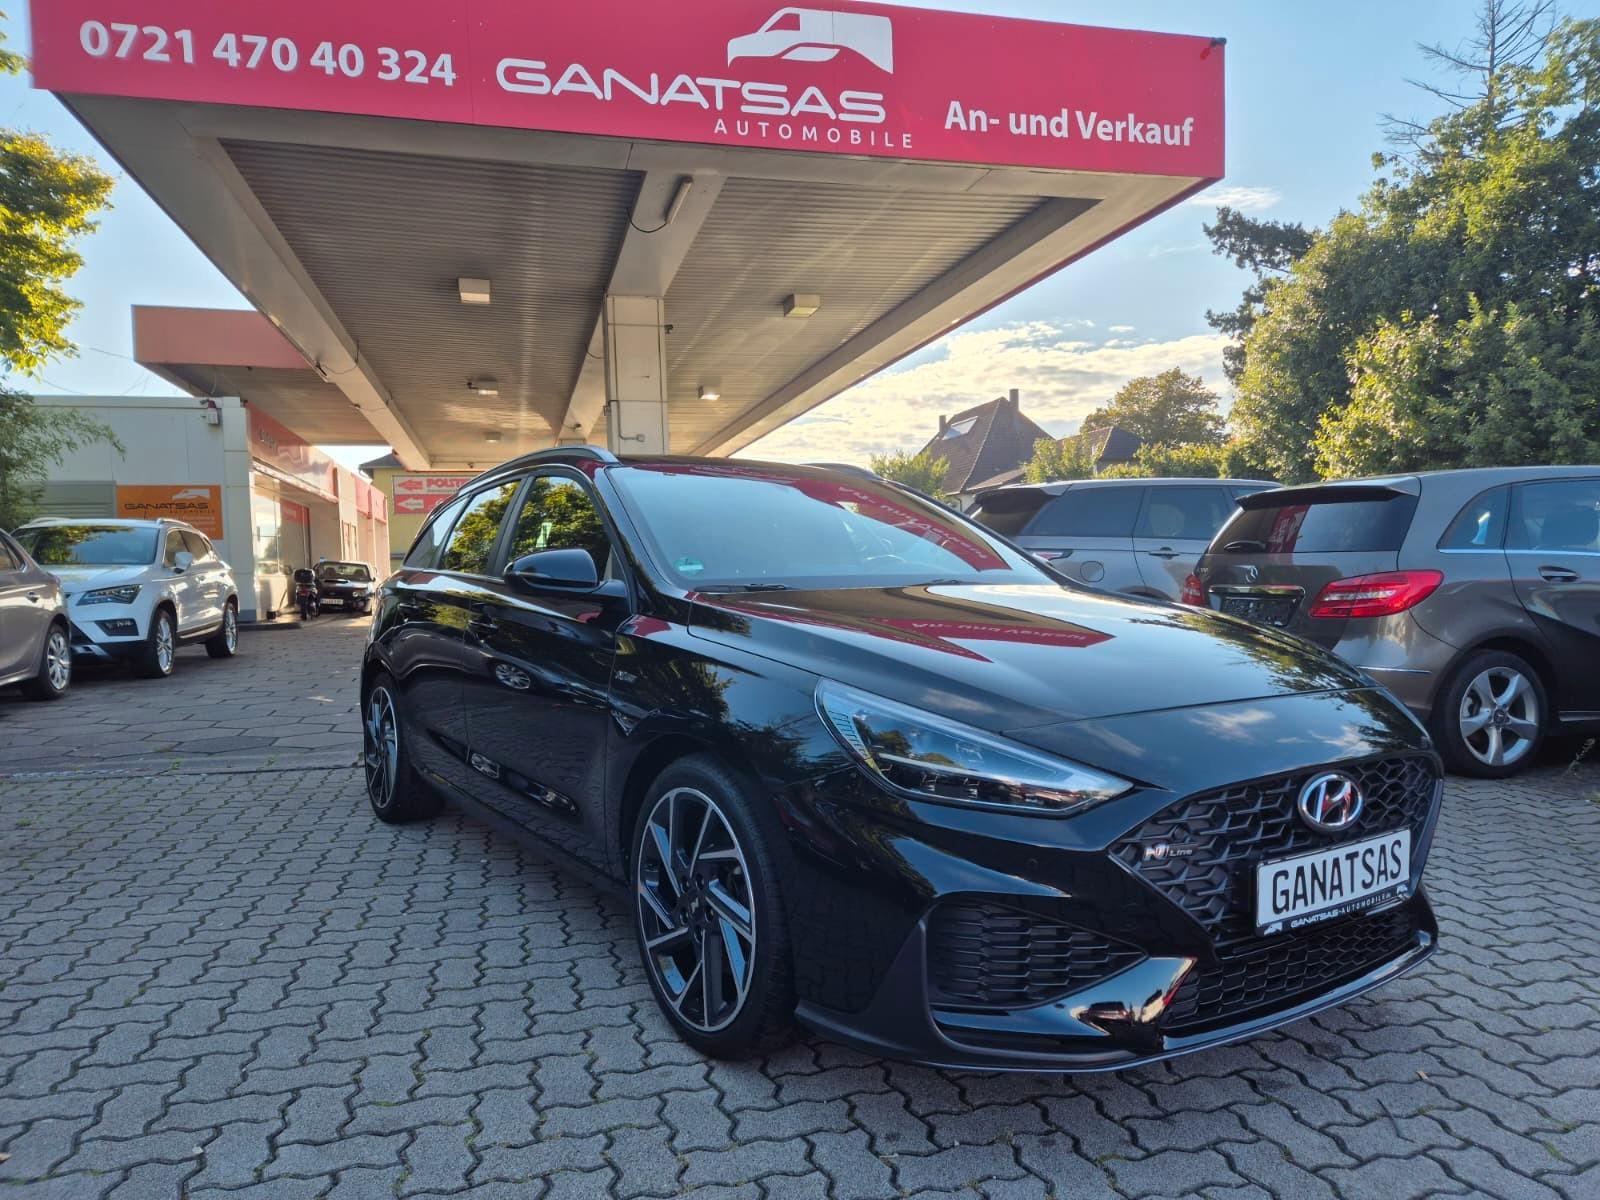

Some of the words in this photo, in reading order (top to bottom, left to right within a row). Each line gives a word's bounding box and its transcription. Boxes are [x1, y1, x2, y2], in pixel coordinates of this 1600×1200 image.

[79, 20, 196, 64] 0721
[213, 32, 298, 72] 470
[310, 41, 364, 77] 40
[377, 47, 456, 86] 324
[496, 57, 887, 123] GANATSAS
[714, 118, 913, 149] AUTOMOBILE
[944, 100, 1000, 132] An-
[1009, 108, 1069, 138] und
[1075, 110, 1194, 146] Verkauf
[124, 502, 209, 510] GANATSAS
[1272, 839, 1402, 915] GANATSAS
